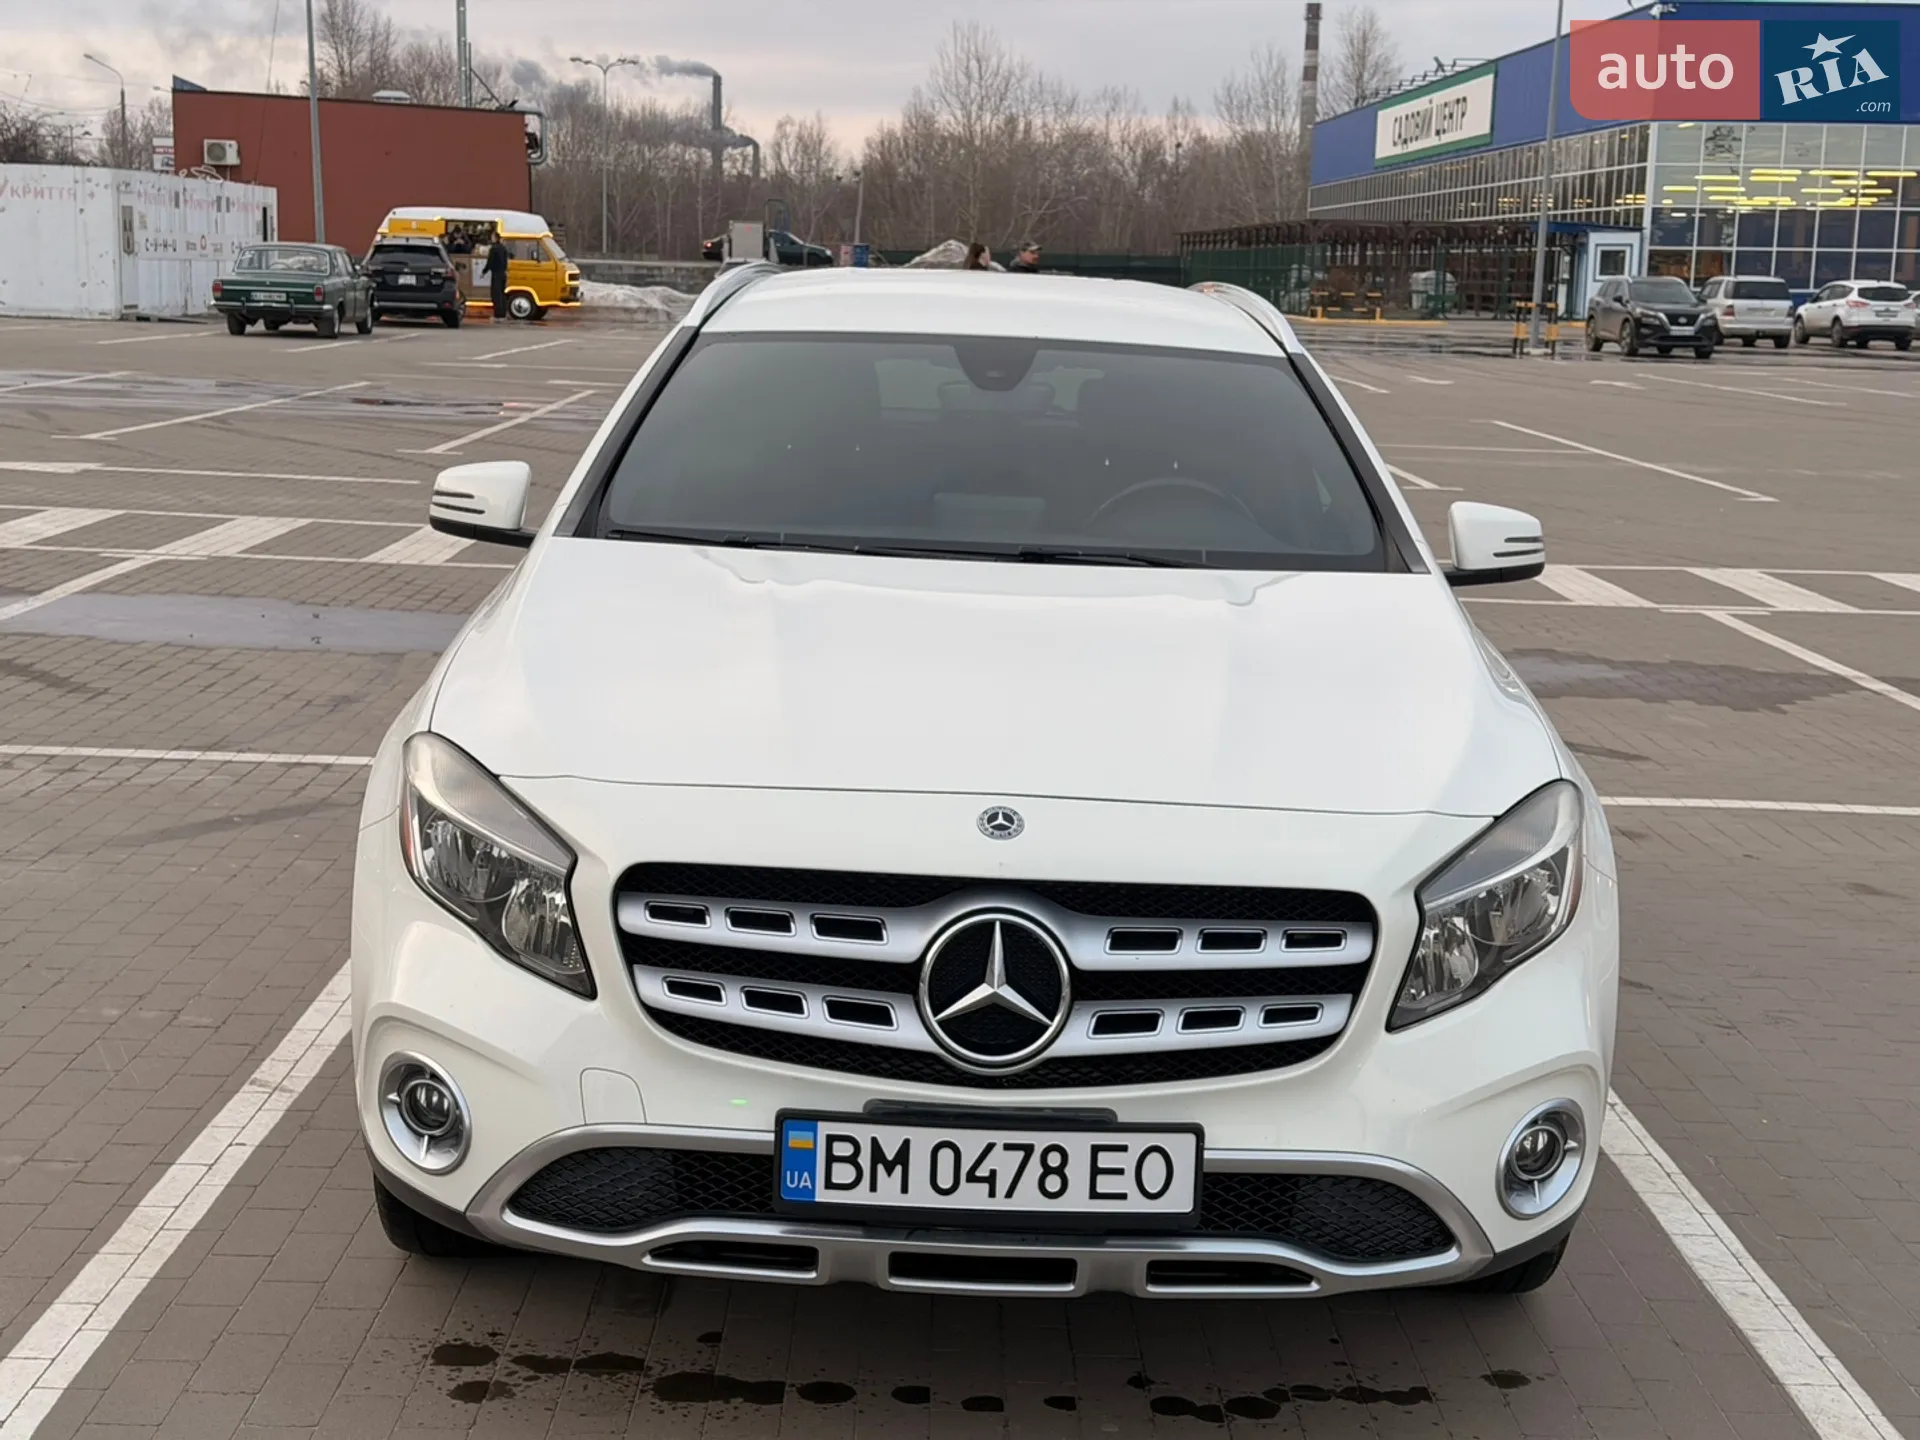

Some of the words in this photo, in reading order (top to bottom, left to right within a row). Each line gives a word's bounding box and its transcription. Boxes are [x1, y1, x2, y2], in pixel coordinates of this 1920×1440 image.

[1435, 95, 1468, 141] ЦЕНТР
[786, 1170, 813, 1190] UA
[824, 1133, 910, 1194] BM
[929, 1140, 1070, 1200] 0478
[1088, 1143, 1174, 1201] EO
